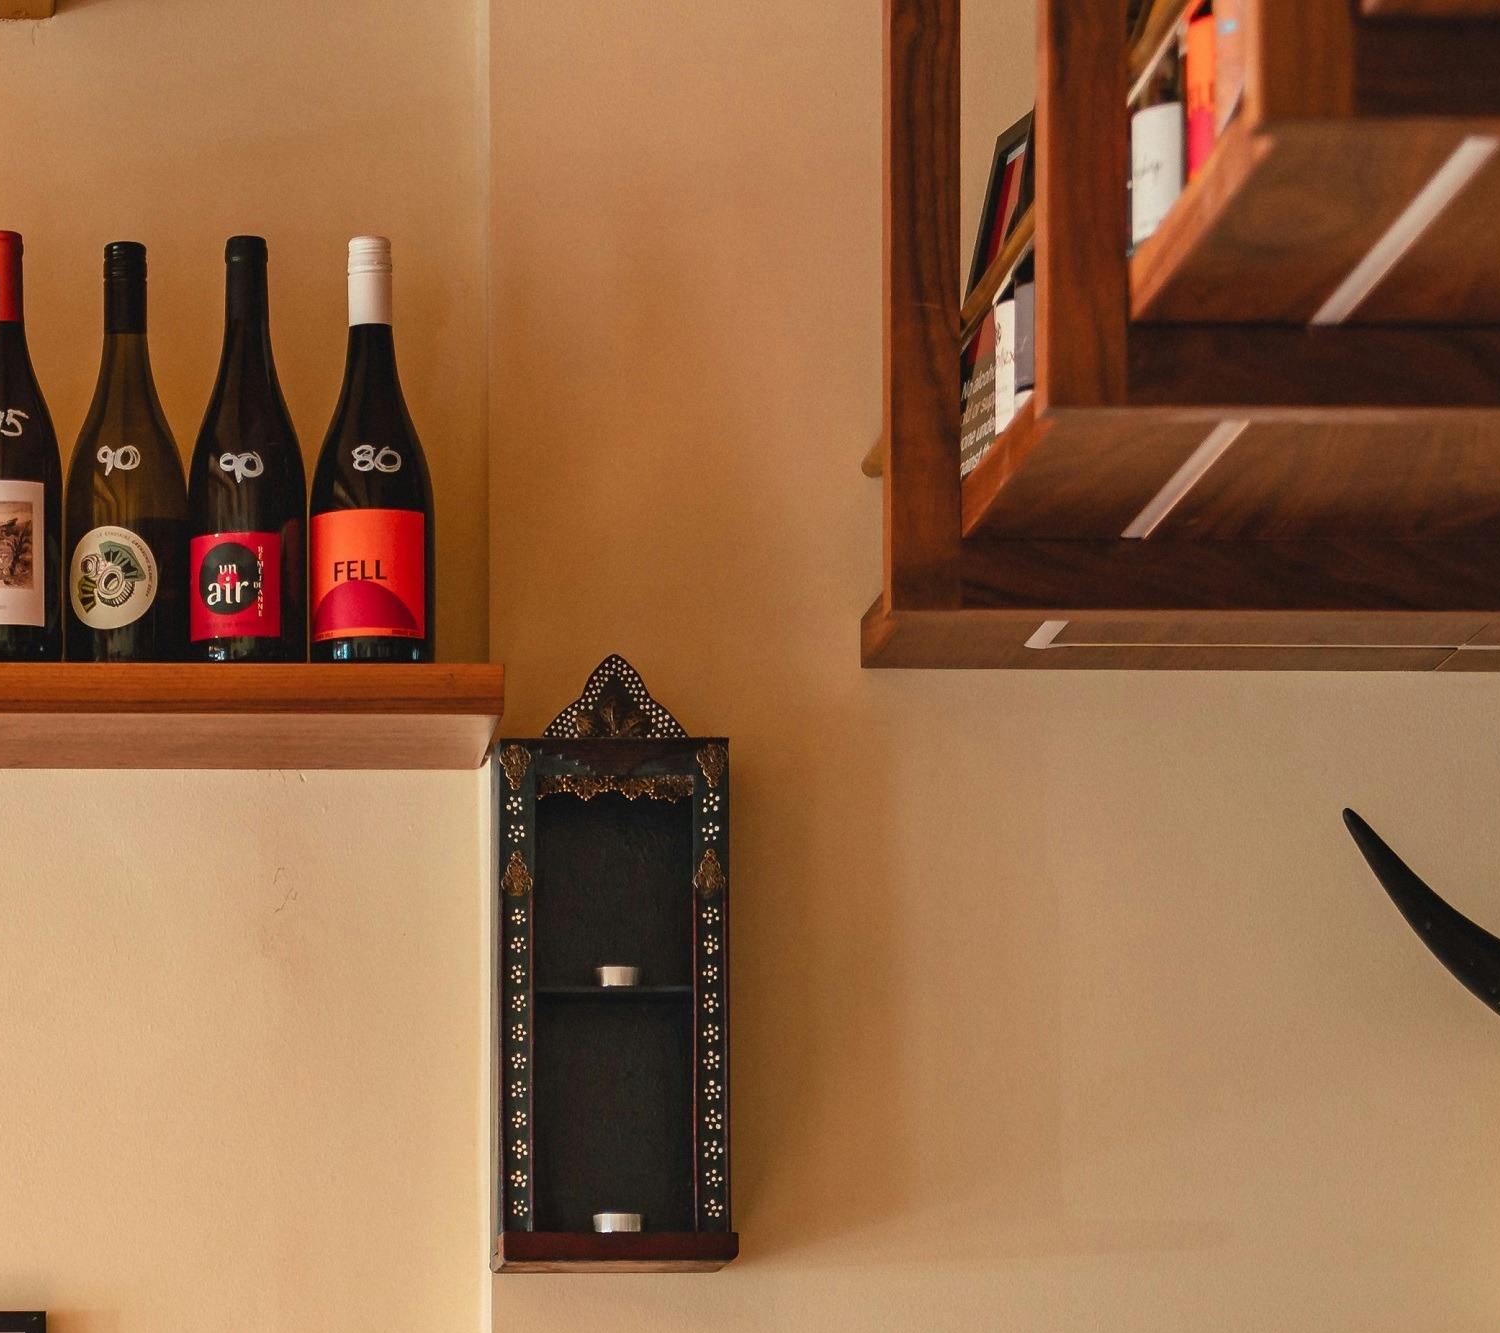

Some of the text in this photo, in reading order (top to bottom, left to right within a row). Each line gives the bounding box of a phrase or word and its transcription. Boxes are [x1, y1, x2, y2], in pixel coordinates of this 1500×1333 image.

[96, 445, 141, 477] 90
[219, 450, 265, 484] 90
[218, 562, 238, 575] un
[333, 559, 388, 582] FELL
[206, 576, 249, 606] air
